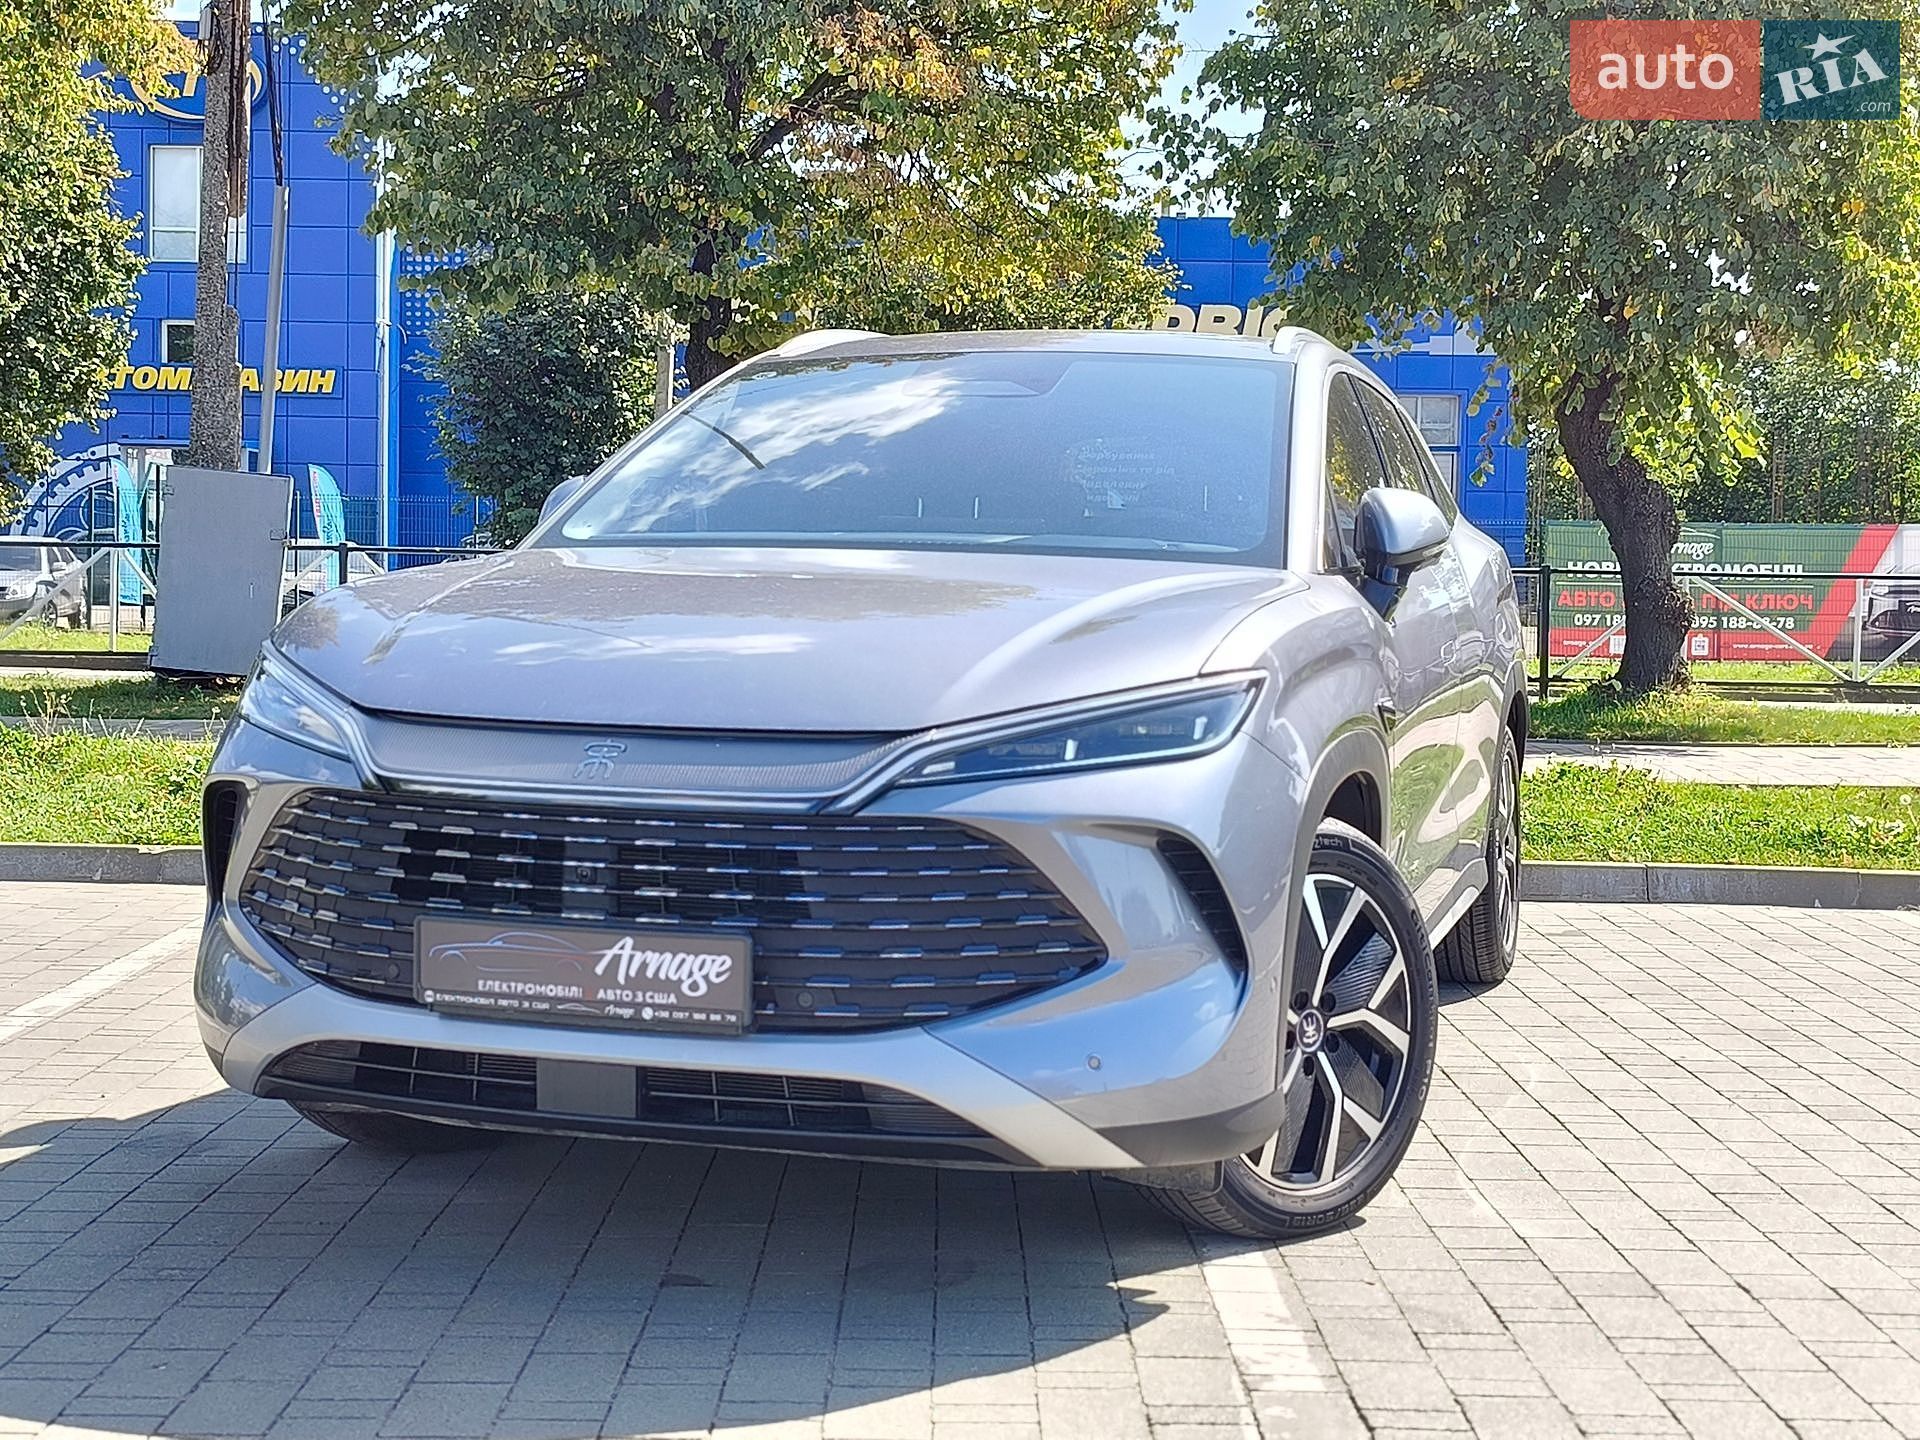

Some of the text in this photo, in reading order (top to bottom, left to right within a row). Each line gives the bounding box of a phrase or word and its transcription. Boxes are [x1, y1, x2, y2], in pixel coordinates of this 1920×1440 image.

[1670, 541, 1714, 560] rnage
[1557, 590, 1616, 608] АВТО
[1745, 593, 1813, 610] КЛЮЧ
[1573, 614, 1602, 626] 097
[594, 936, 733, 997] Arnage
[477, 979, 583, 998] ЕЛЕКТРОМОБІЛІ
[597, 988, 634, 1002] АВТО
[645, 992, 678, 1004] США
